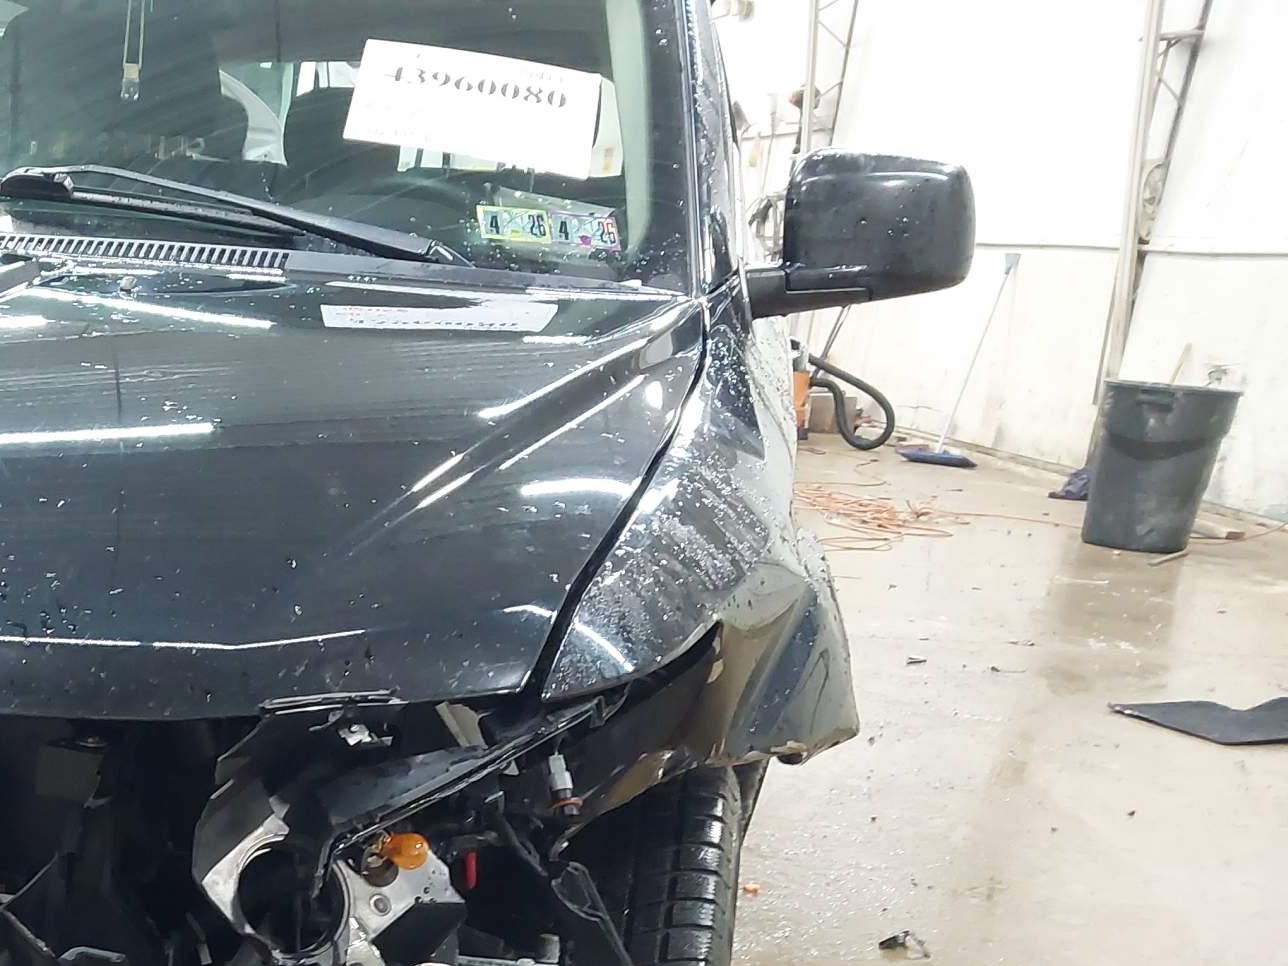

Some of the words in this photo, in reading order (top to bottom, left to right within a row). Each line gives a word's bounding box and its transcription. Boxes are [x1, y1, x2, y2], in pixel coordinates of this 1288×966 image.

[384, 66, 567, 108] 43960080
[489, 215, 500, 235] 4
[527, 213, 547, 237] 26
[558, 220, 570, 241] 4
